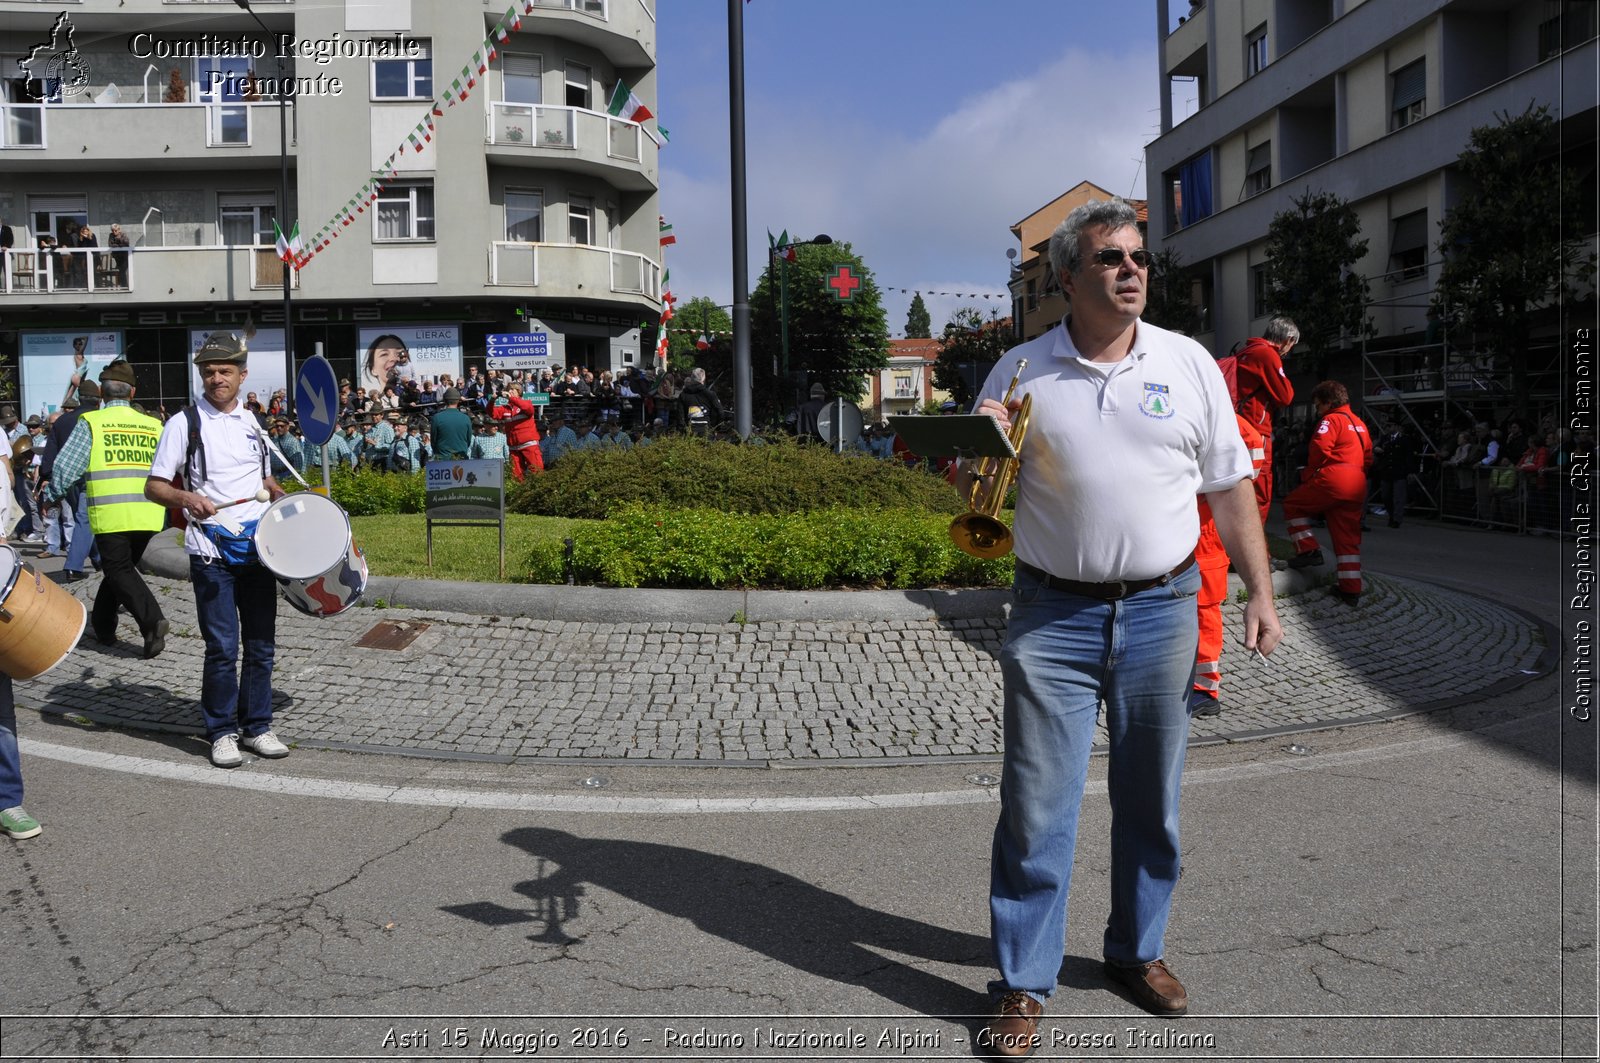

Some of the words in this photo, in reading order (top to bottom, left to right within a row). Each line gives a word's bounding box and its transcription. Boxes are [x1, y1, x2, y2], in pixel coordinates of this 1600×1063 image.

[416, 331, 452, 339] LIERAC
[507, 347, 546, 355] CHIVASSO
[103, 433, 158, 449] SERVIZIO
[104, 450, 155, 463] D'ORDIN
[428, 468, 451, 480] sara
